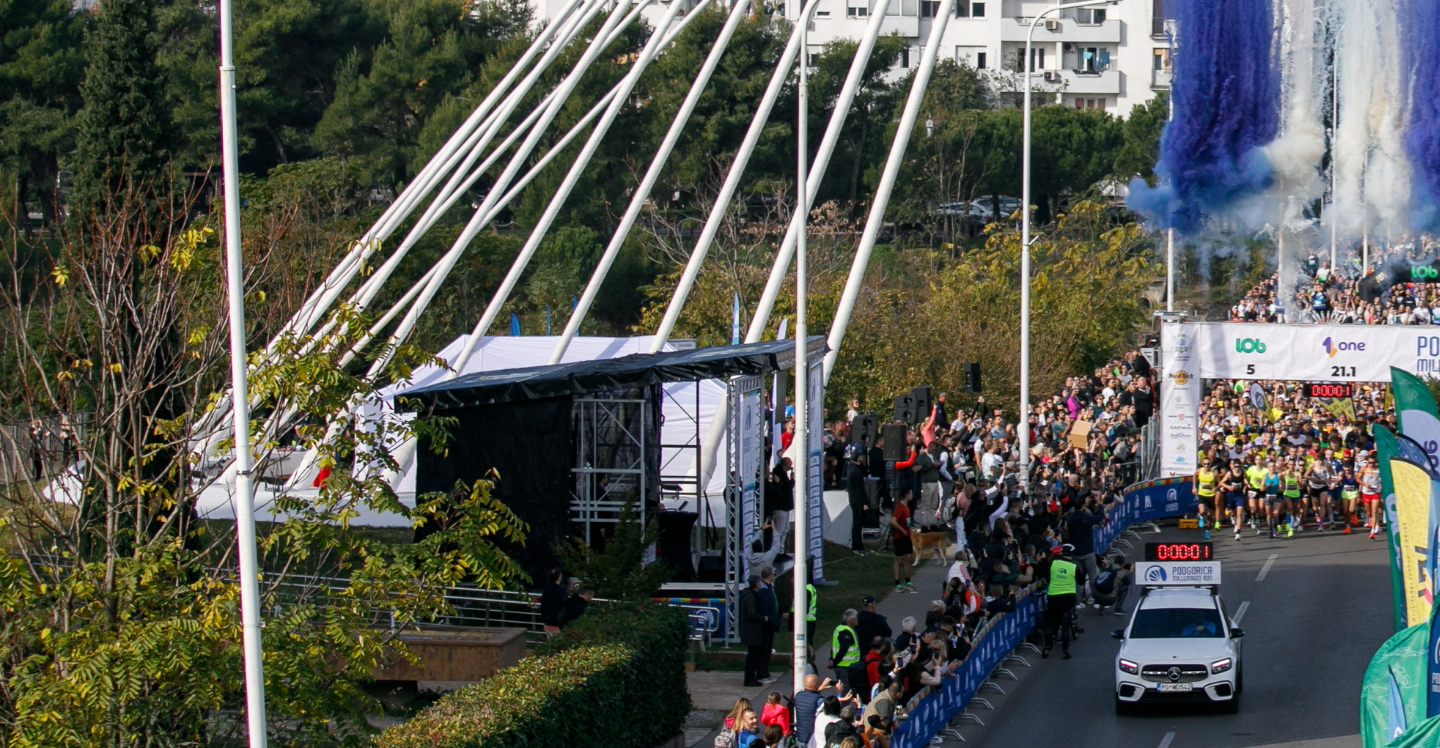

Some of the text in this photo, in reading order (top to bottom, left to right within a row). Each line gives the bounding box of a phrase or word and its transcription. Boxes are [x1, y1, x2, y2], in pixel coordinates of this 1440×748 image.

[1246, 364, 1256, 375] 5
[1331, 366, 1356, 377] 21.1
[1311, 384, 1350, 397] 0:00:01
[1157, 544, 1209, 560] 0:00:01
[1172, 566, 1213, 575] PODGORICA
